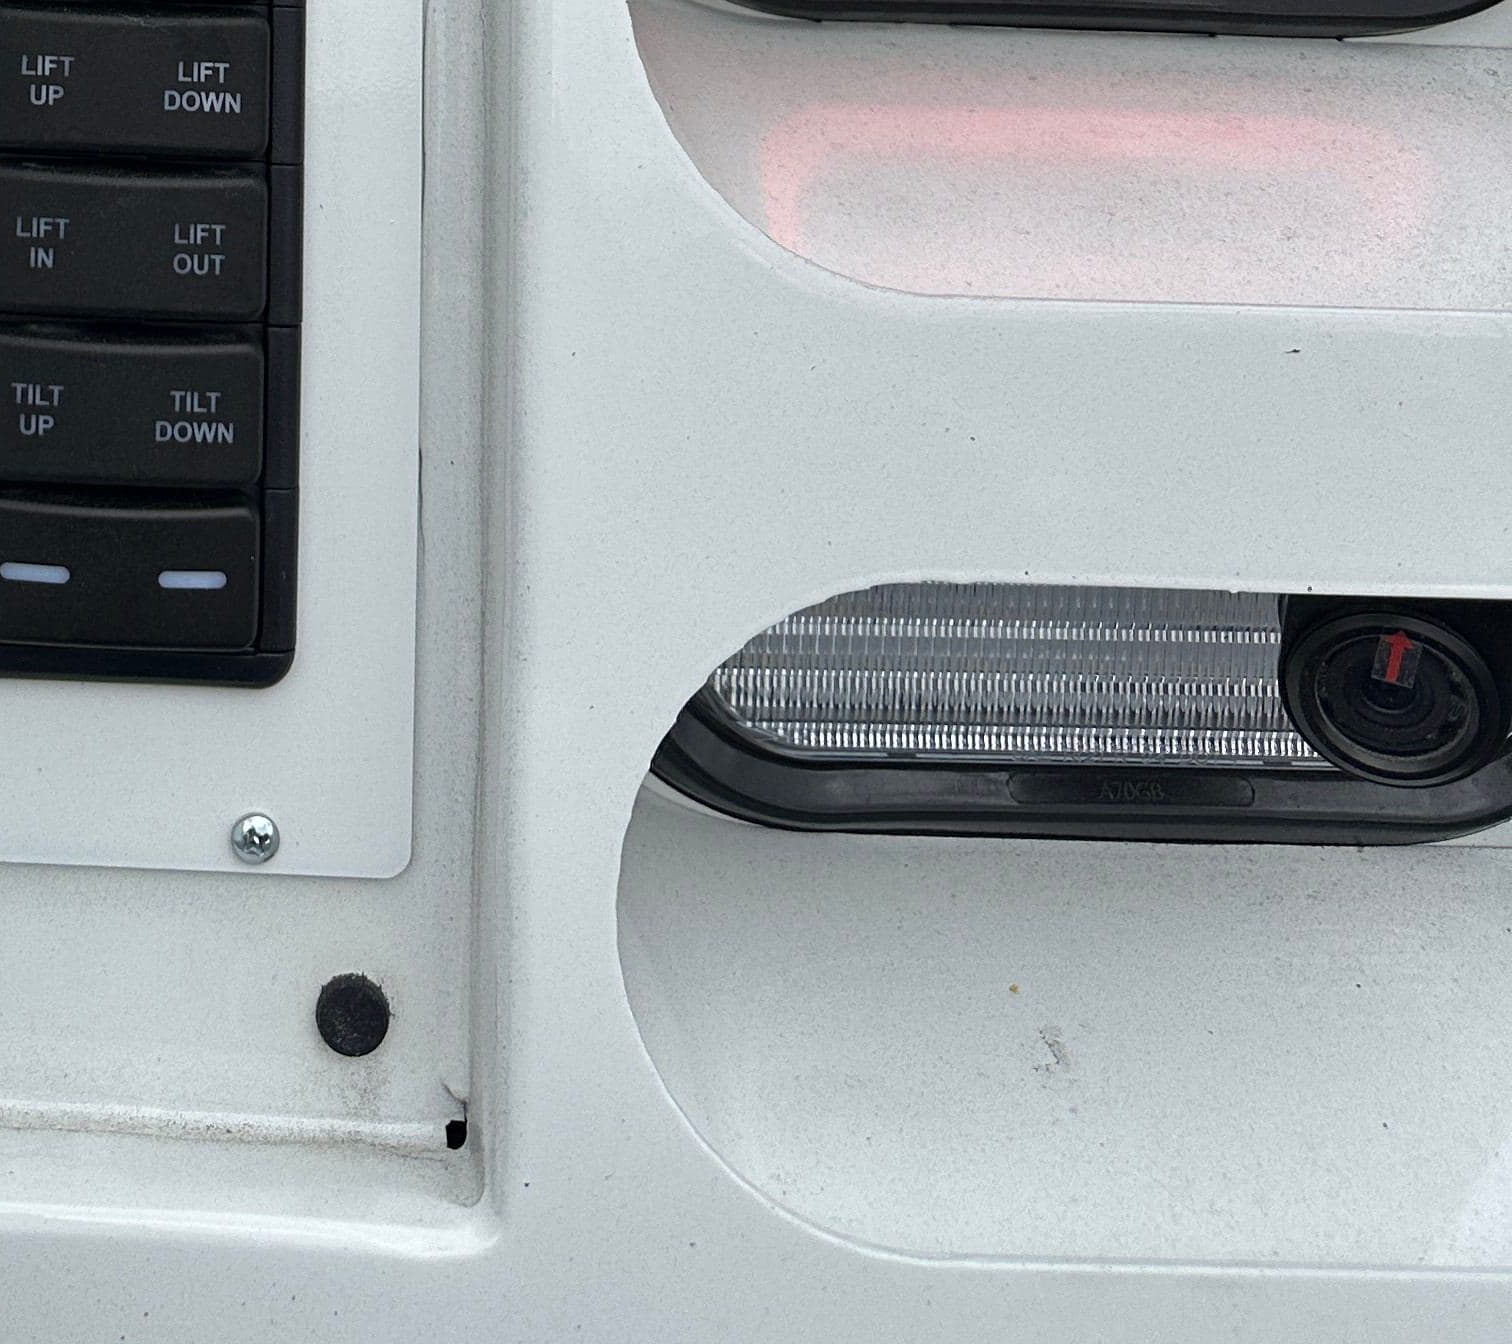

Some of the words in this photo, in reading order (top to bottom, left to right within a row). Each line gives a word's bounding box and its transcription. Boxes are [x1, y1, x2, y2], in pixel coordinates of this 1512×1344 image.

[21, 55, 74, 76] LIFT
[178, 61, 230, 83] LIFT
[29, 84, 64, 105] UP
[164, 90, 241, 114] DOWN
[16, 217, 70, 239] LIFT
[174, 223, 226, 245] LIFT
[30, 246, 54, 268] IN
[173, 253, 225, 275] OUT
[11, 382, 64, 406] TILT
[170, 390, 221, 413] TILT
[19, 414, 54, 436] UP
[155, 421, 234, 444] DOWN
